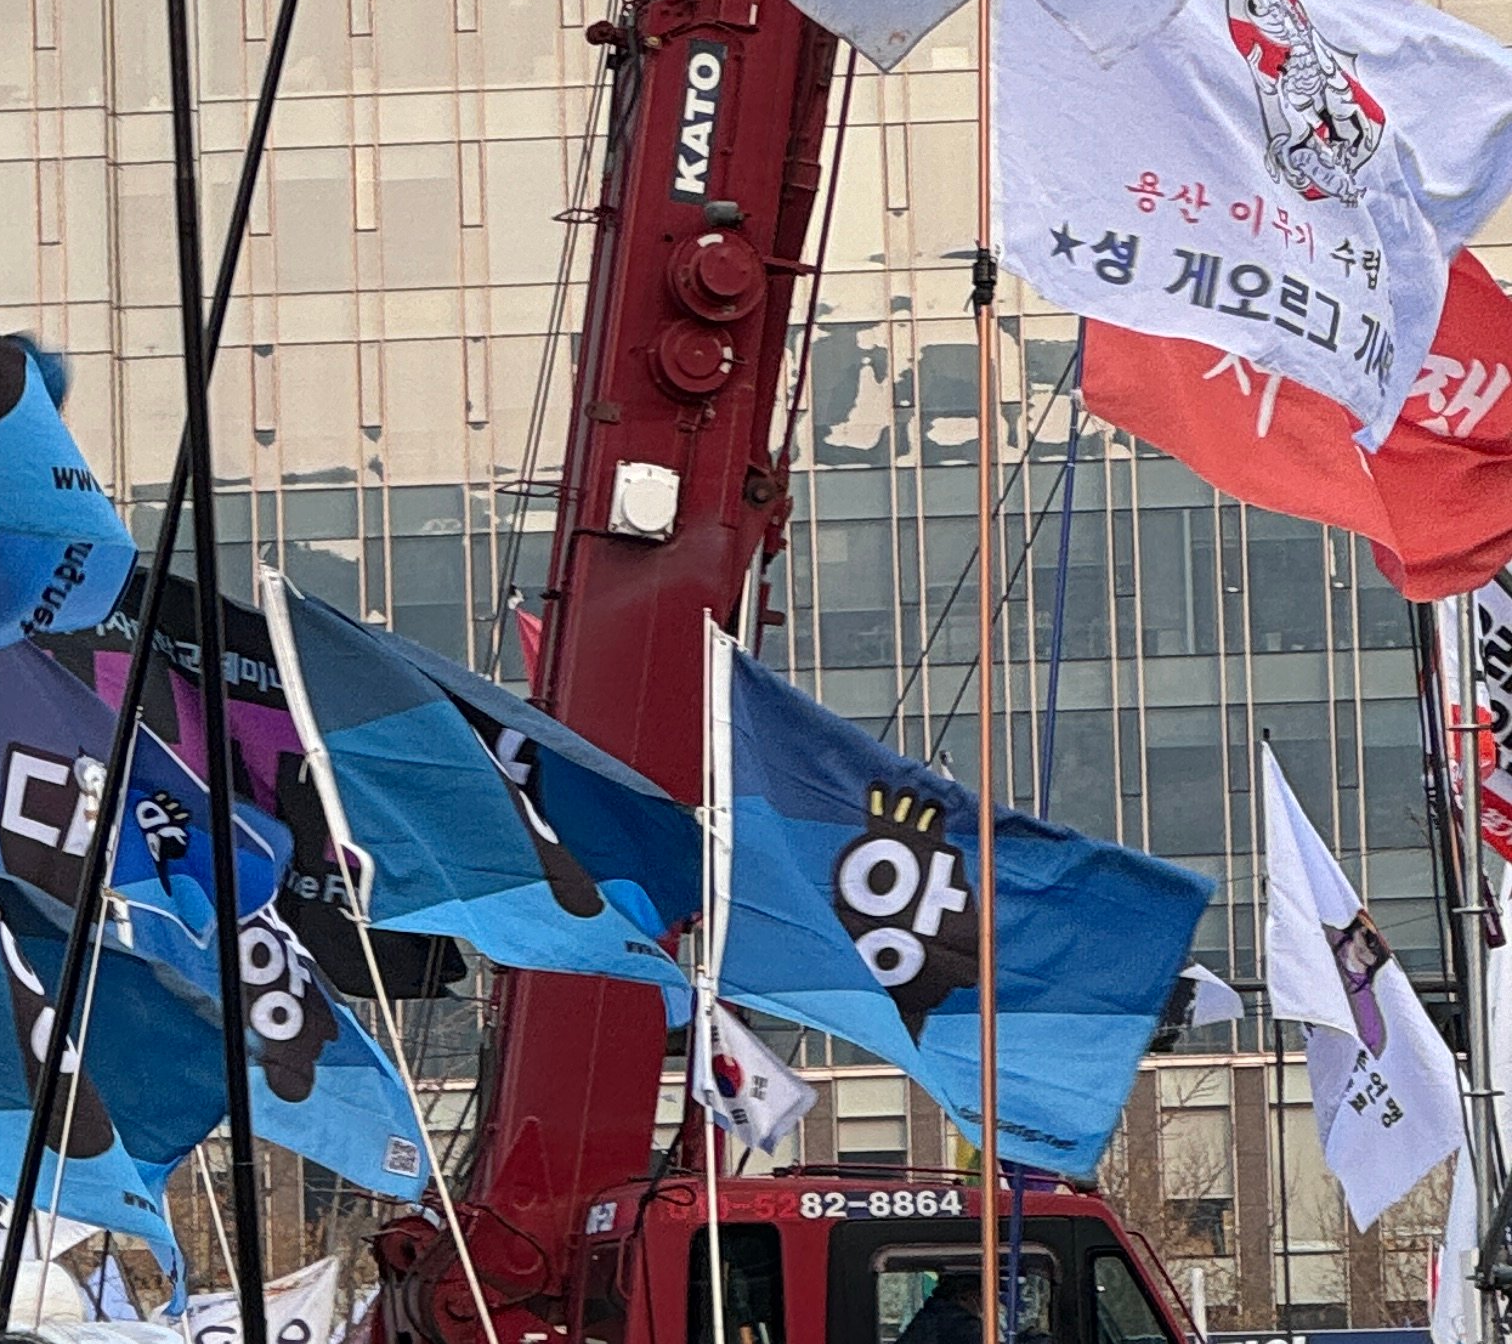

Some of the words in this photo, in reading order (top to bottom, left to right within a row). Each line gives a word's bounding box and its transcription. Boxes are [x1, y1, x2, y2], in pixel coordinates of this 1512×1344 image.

[673, 51, 723, 196] KATO
[1125, 171, 1211, 224] 용산
[1163, 248, 1341, 353] 게오르그
[839, 838, 968, 988] 앙
